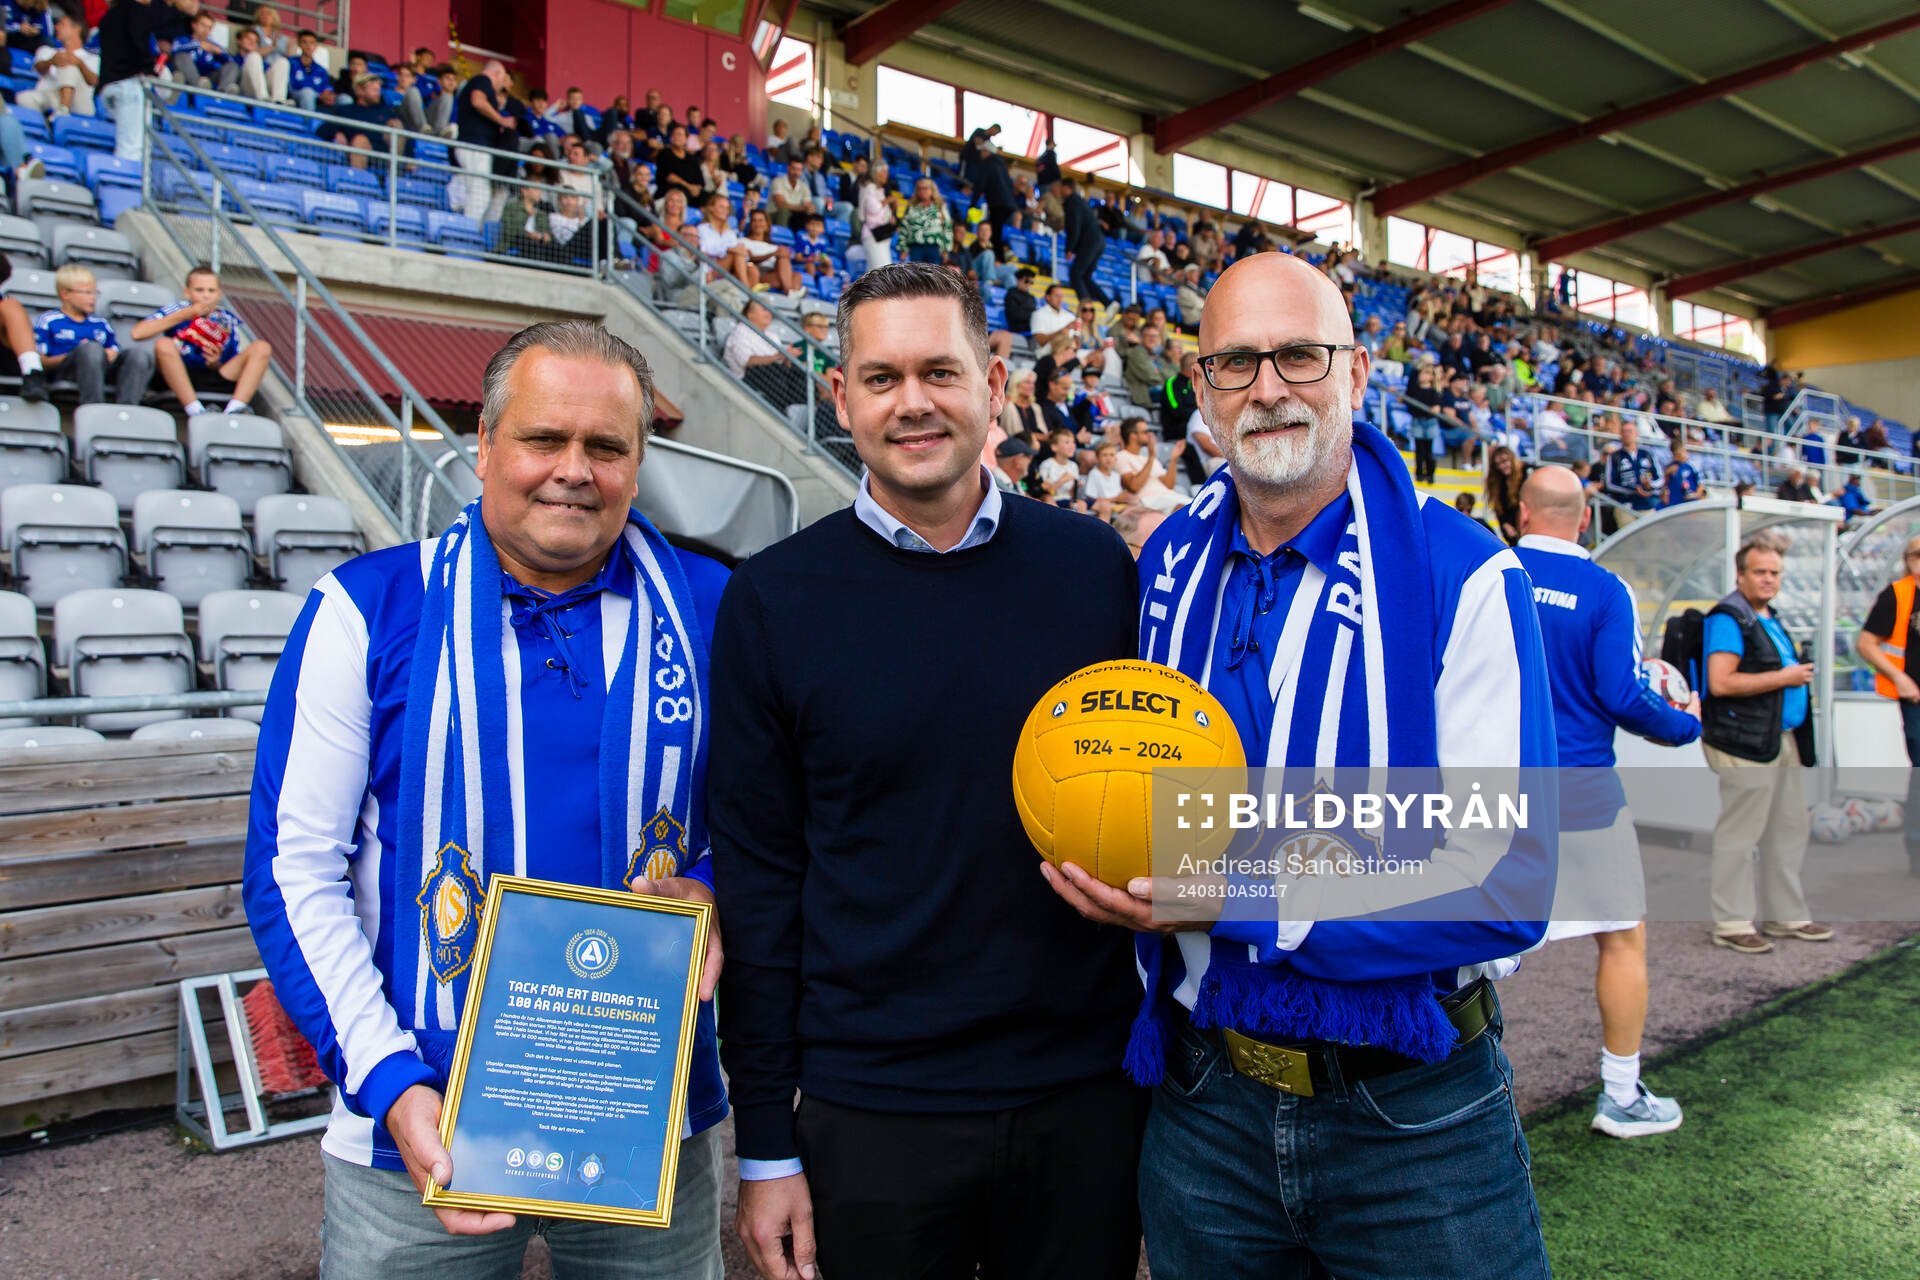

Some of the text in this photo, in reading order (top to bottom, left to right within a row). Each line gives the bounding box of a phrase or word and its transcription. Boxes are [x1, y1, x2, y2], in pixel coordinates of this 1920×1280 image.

[722, 52, 736, 71] C
[1326, 522, 1363, 626] RA
[1532, 586, 1578, 610] STUNA
[1058, 664, 1153, 689] Allsvenskan
[1157, 669, 1186, 684] 100
[1081, 689, 1181, 719] SELECT
[1074, 739, 1113, 755] 1924
[1137, 741, 1183, 761] 2024
[507, 980, 660, 1009] TACK FÖR ERT BIDRAG TILL
[507, 995, 656, 1023] 100 ÅR AV ALLSVENSKAN
